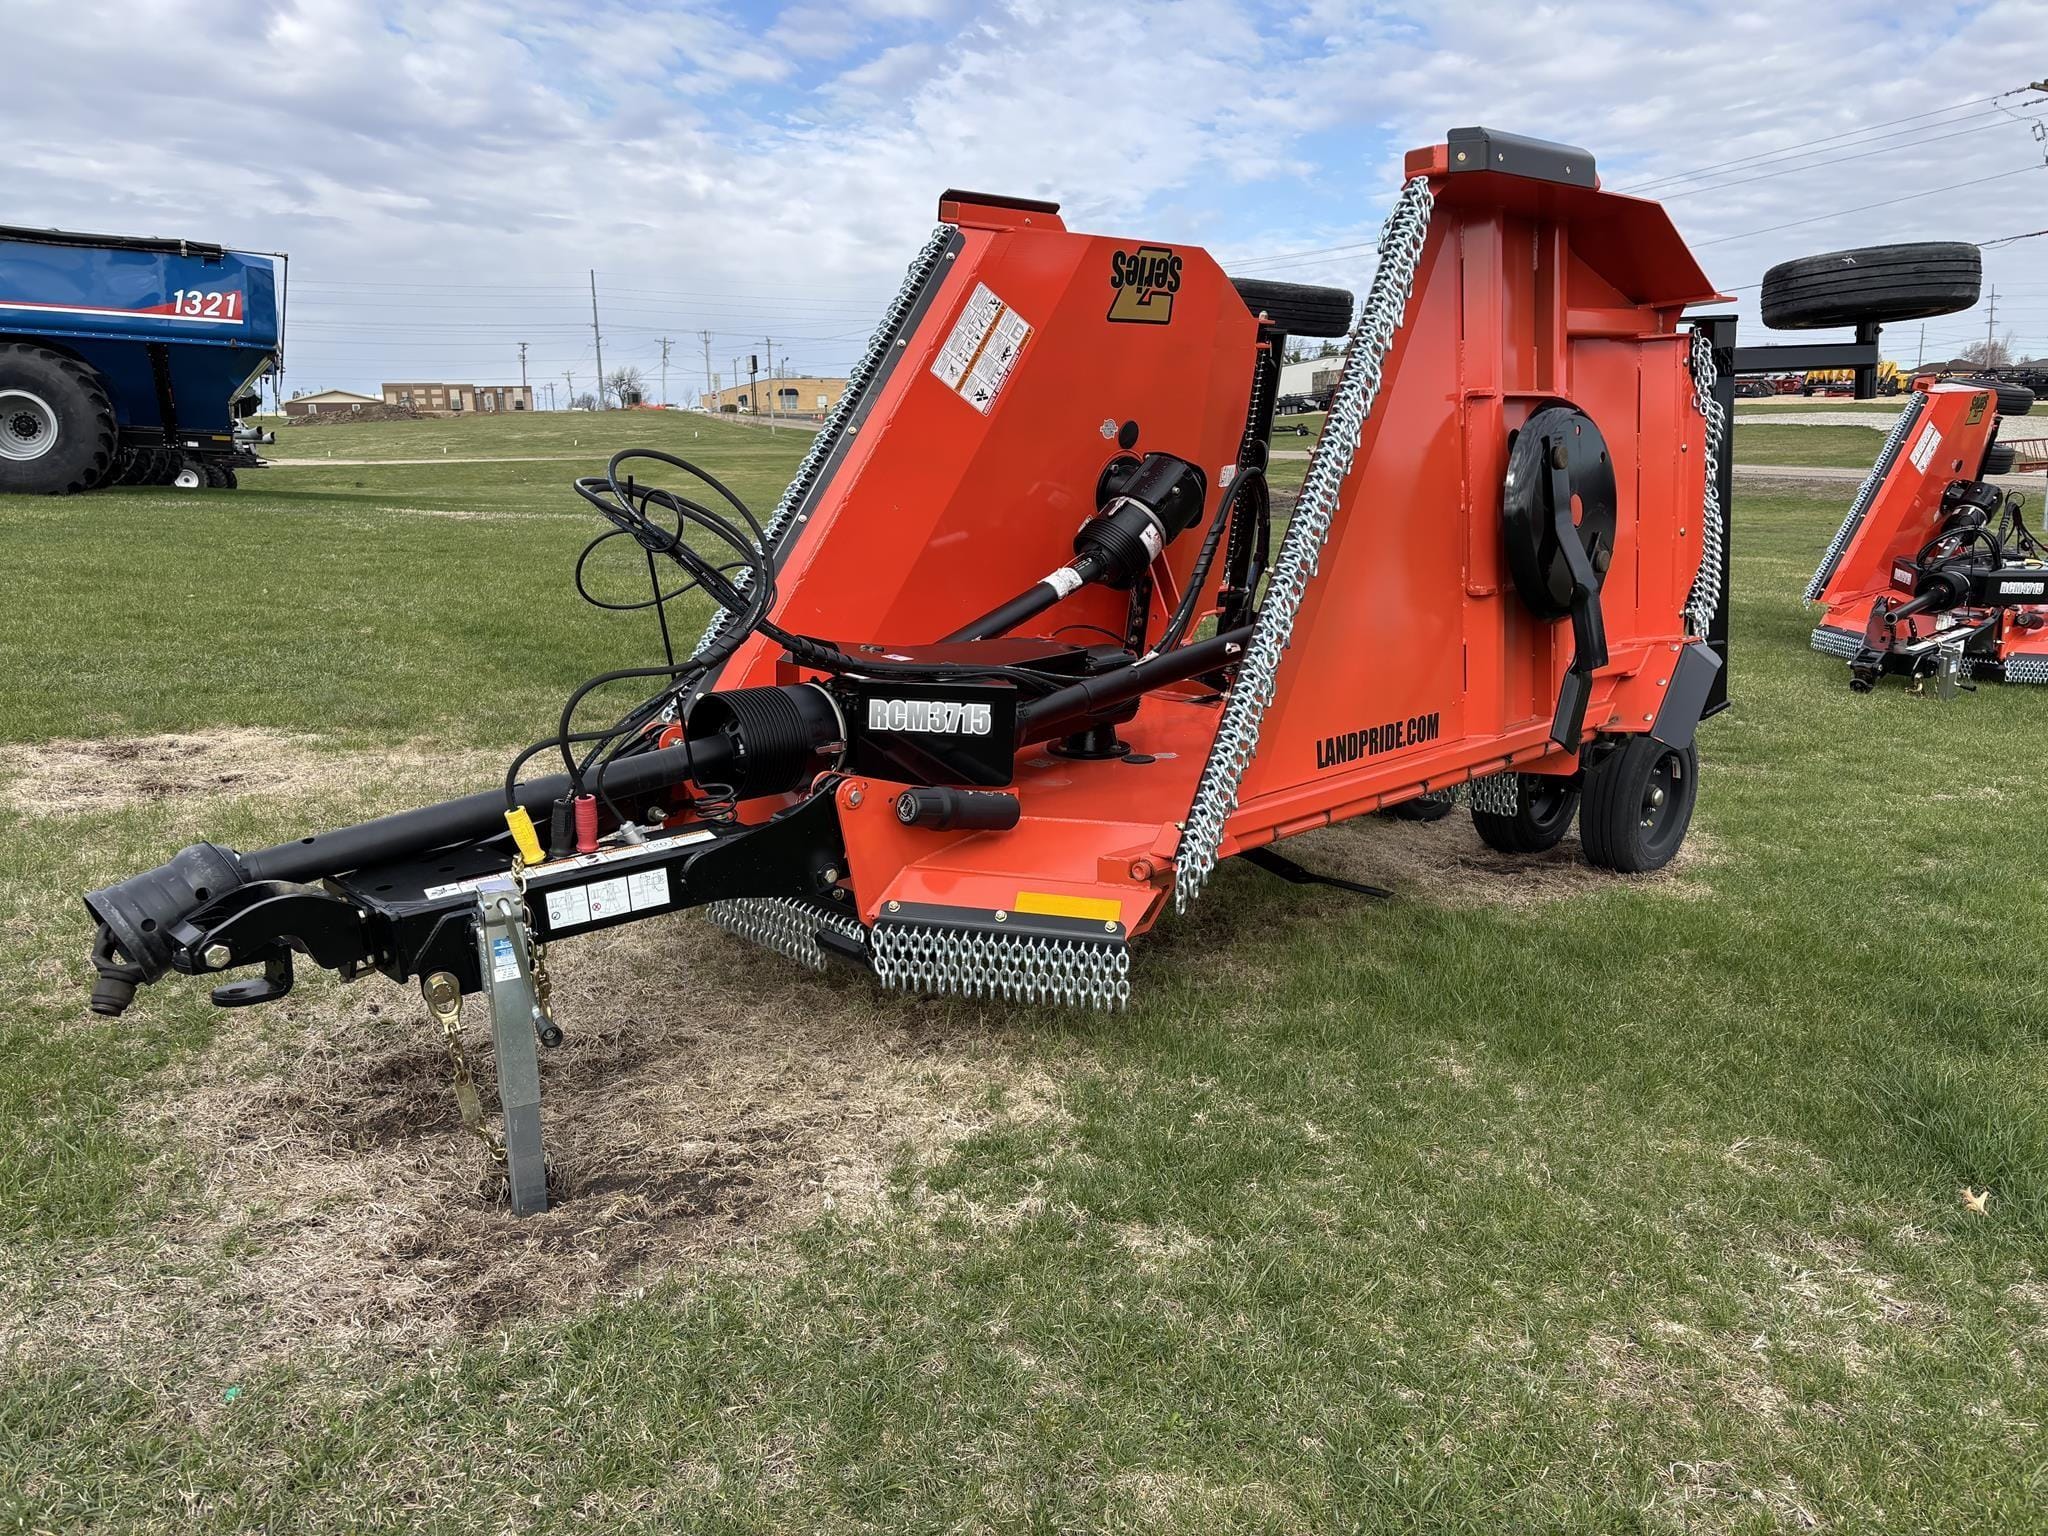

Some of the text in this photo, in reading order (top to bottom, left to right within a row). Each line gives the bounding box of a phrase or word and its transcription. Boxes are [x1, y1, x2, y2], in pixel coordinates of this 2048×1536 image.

[1110, 250, 1182, 294] Series
[174, 289, 236, 317] 1321
[869, 699, 992, 735] RCM3715
[1316, 712, 1440, 769] LANDPRIDE.COM
